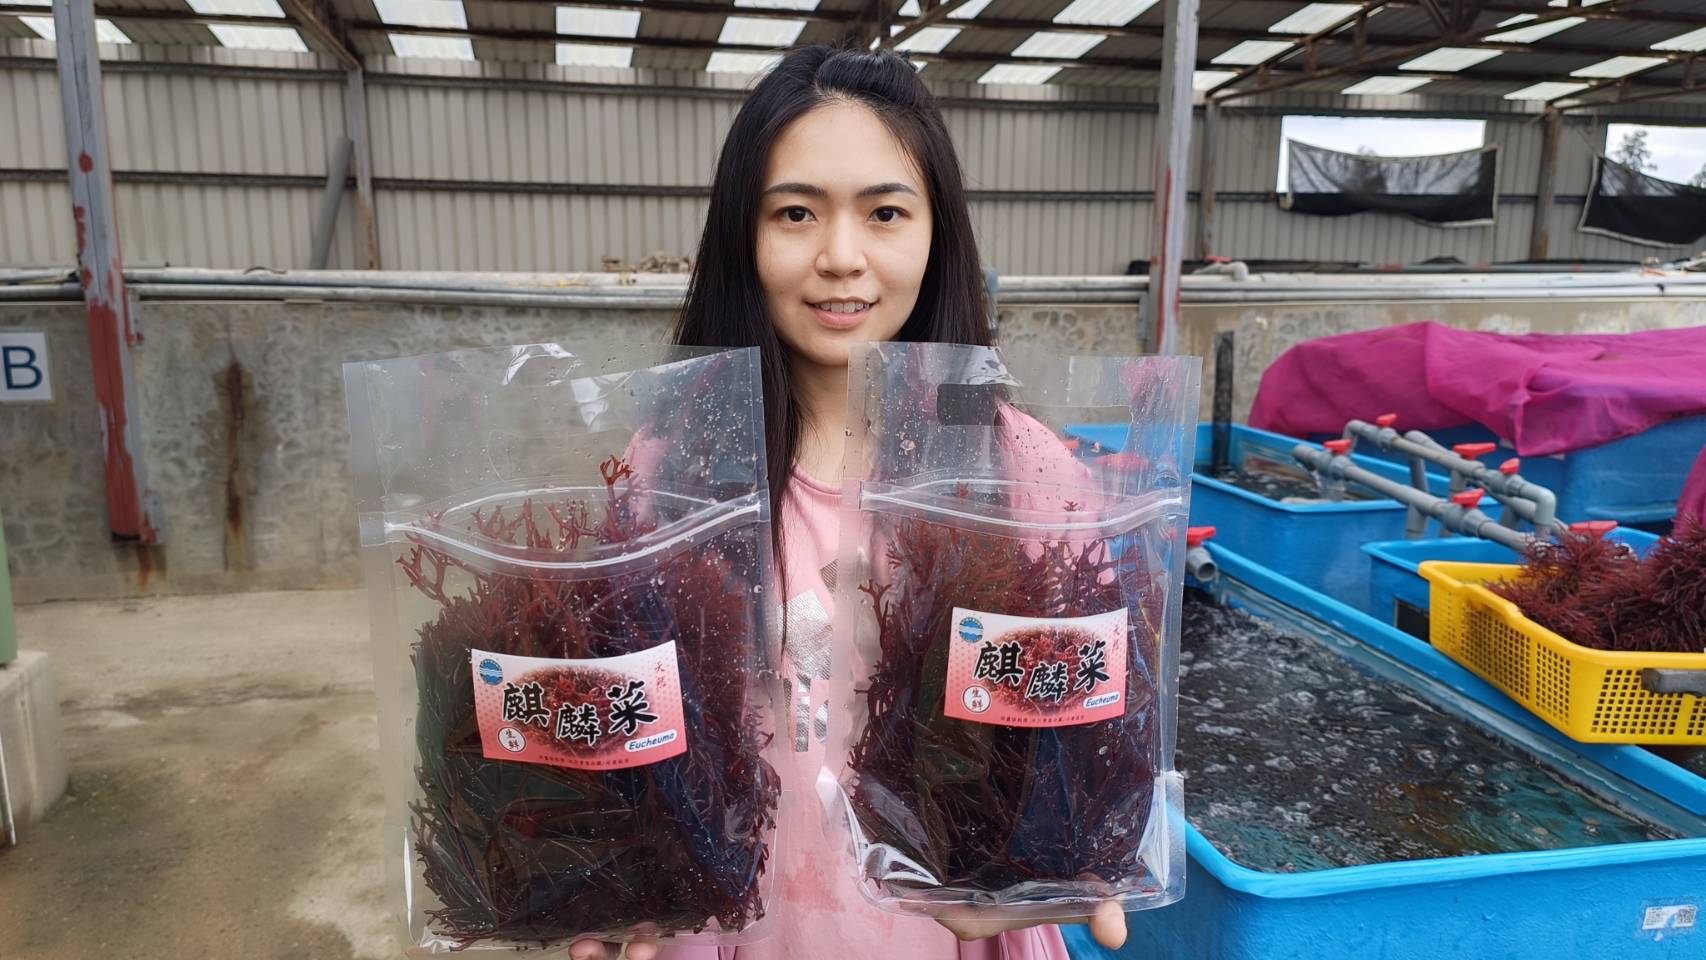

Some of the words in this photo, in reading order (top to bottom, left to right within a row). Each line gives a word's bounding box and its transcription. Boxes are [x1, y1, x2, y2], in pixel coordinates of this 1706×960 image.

[2, 346, 43, 389] B
[973, 640, 1110, 702] 麒麟菜
[502, 680, 659, 745] 麒麟菜
[1085, 693, 1119, 708] Eucheuma
[628, 732, 675, 751] Eucheuma
